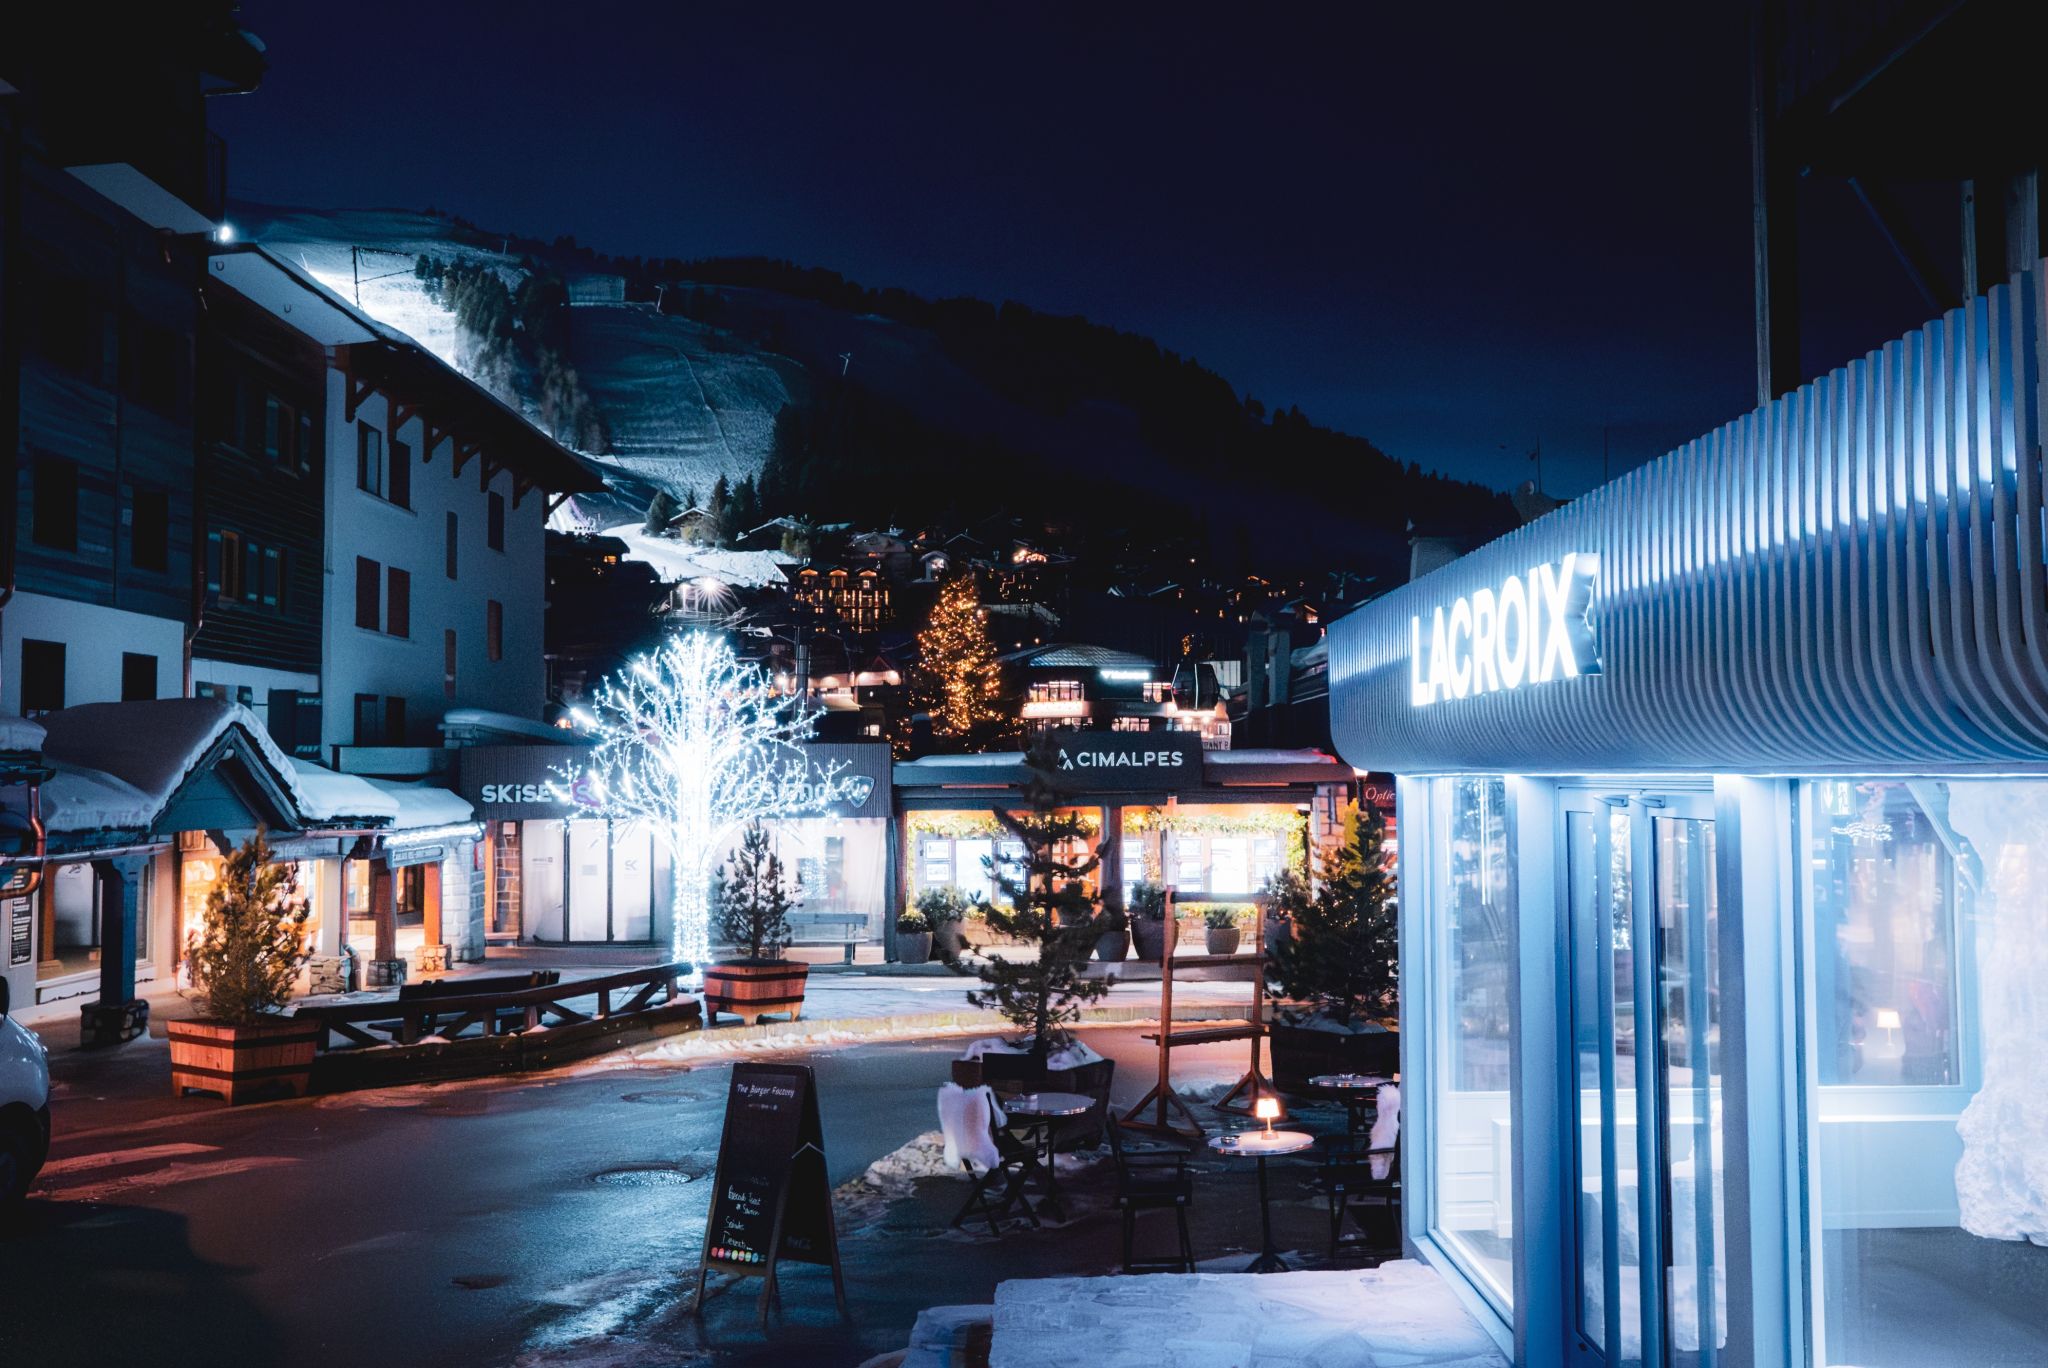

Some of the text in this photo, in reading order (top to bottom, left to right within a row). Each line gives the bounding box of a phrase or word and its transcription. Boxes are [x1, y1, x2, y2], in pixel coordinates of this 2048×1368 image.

[1412, 552, 1578, 707] LACROIX
[1076, 751, 1183, 768] CIMALPES
[737, 1084, 749, 1094] The
[750, 1084, 771, 1096] Burger
